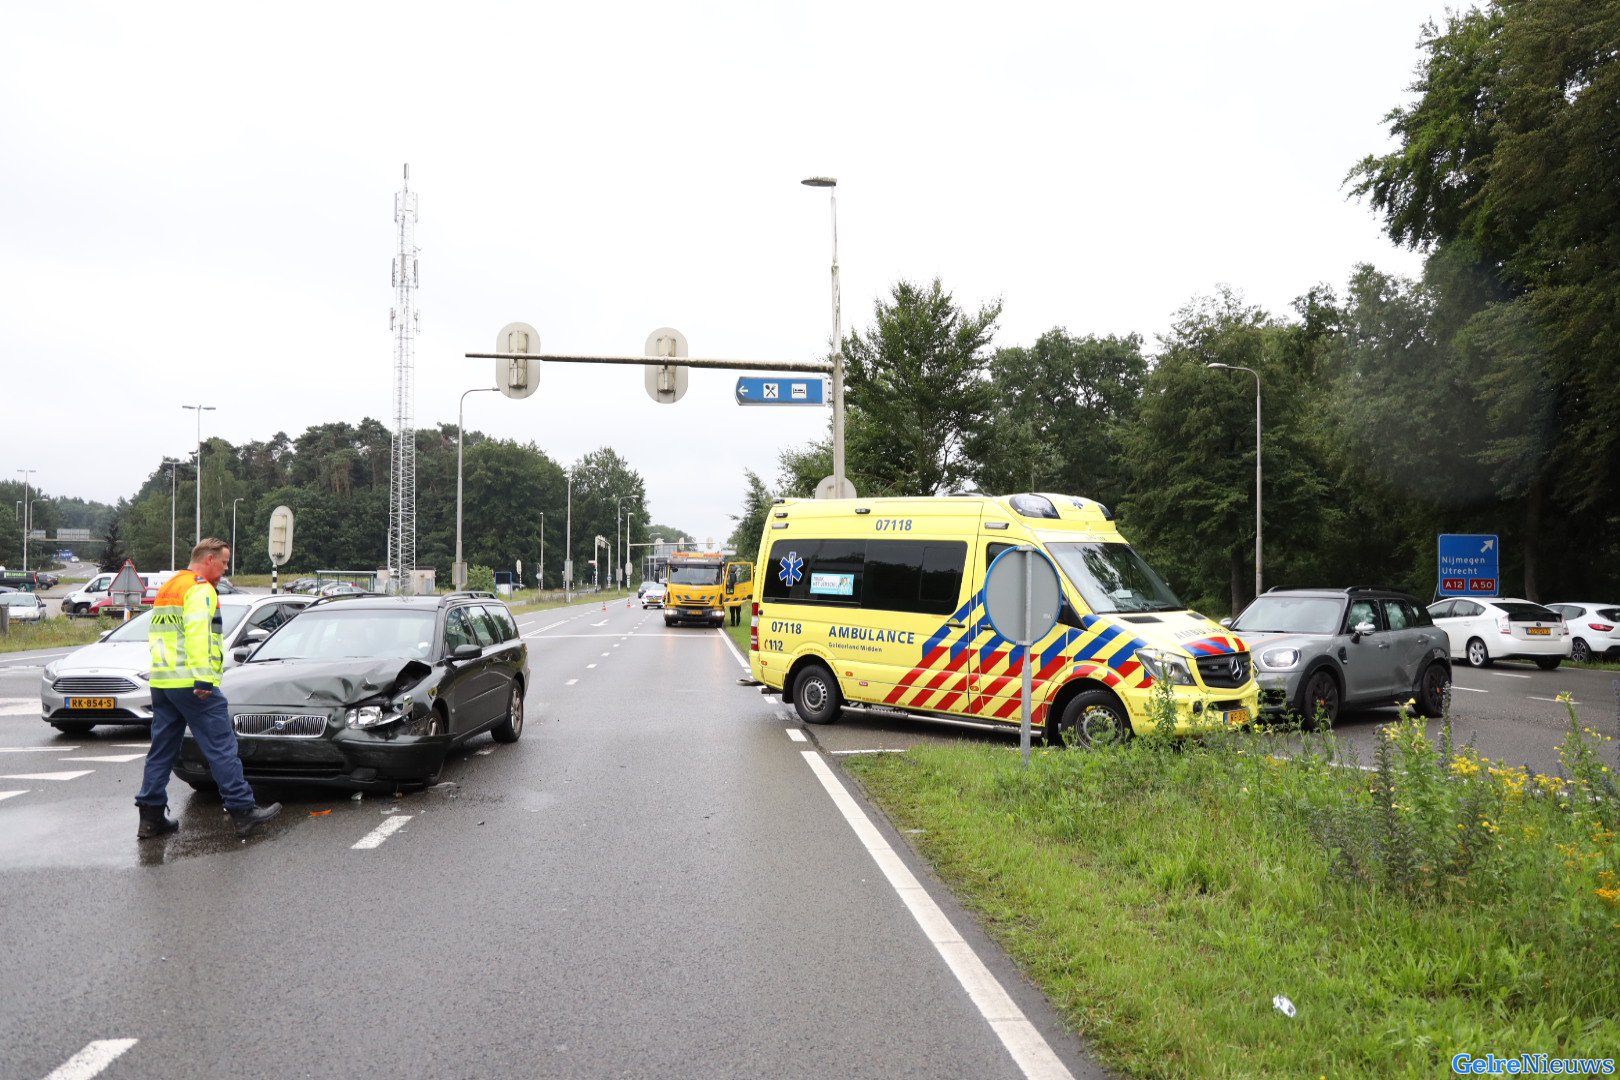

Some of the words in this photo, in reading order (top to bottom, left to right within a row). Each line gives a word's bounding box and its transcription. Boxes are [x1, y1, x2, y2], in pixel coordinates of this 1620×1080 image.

[875, 519, 913, 531] 07118
[1441, 555, 1486, 566] Nijmegen
[1441, 567, 1478, 575] Utrecht
[771, 621, 802, 635] 07118
[828, 625, 915, 645] AMBULANCE
[828, 642, 860, 651] Gelderland
[72, 699, 112, 708] RK-854-S
